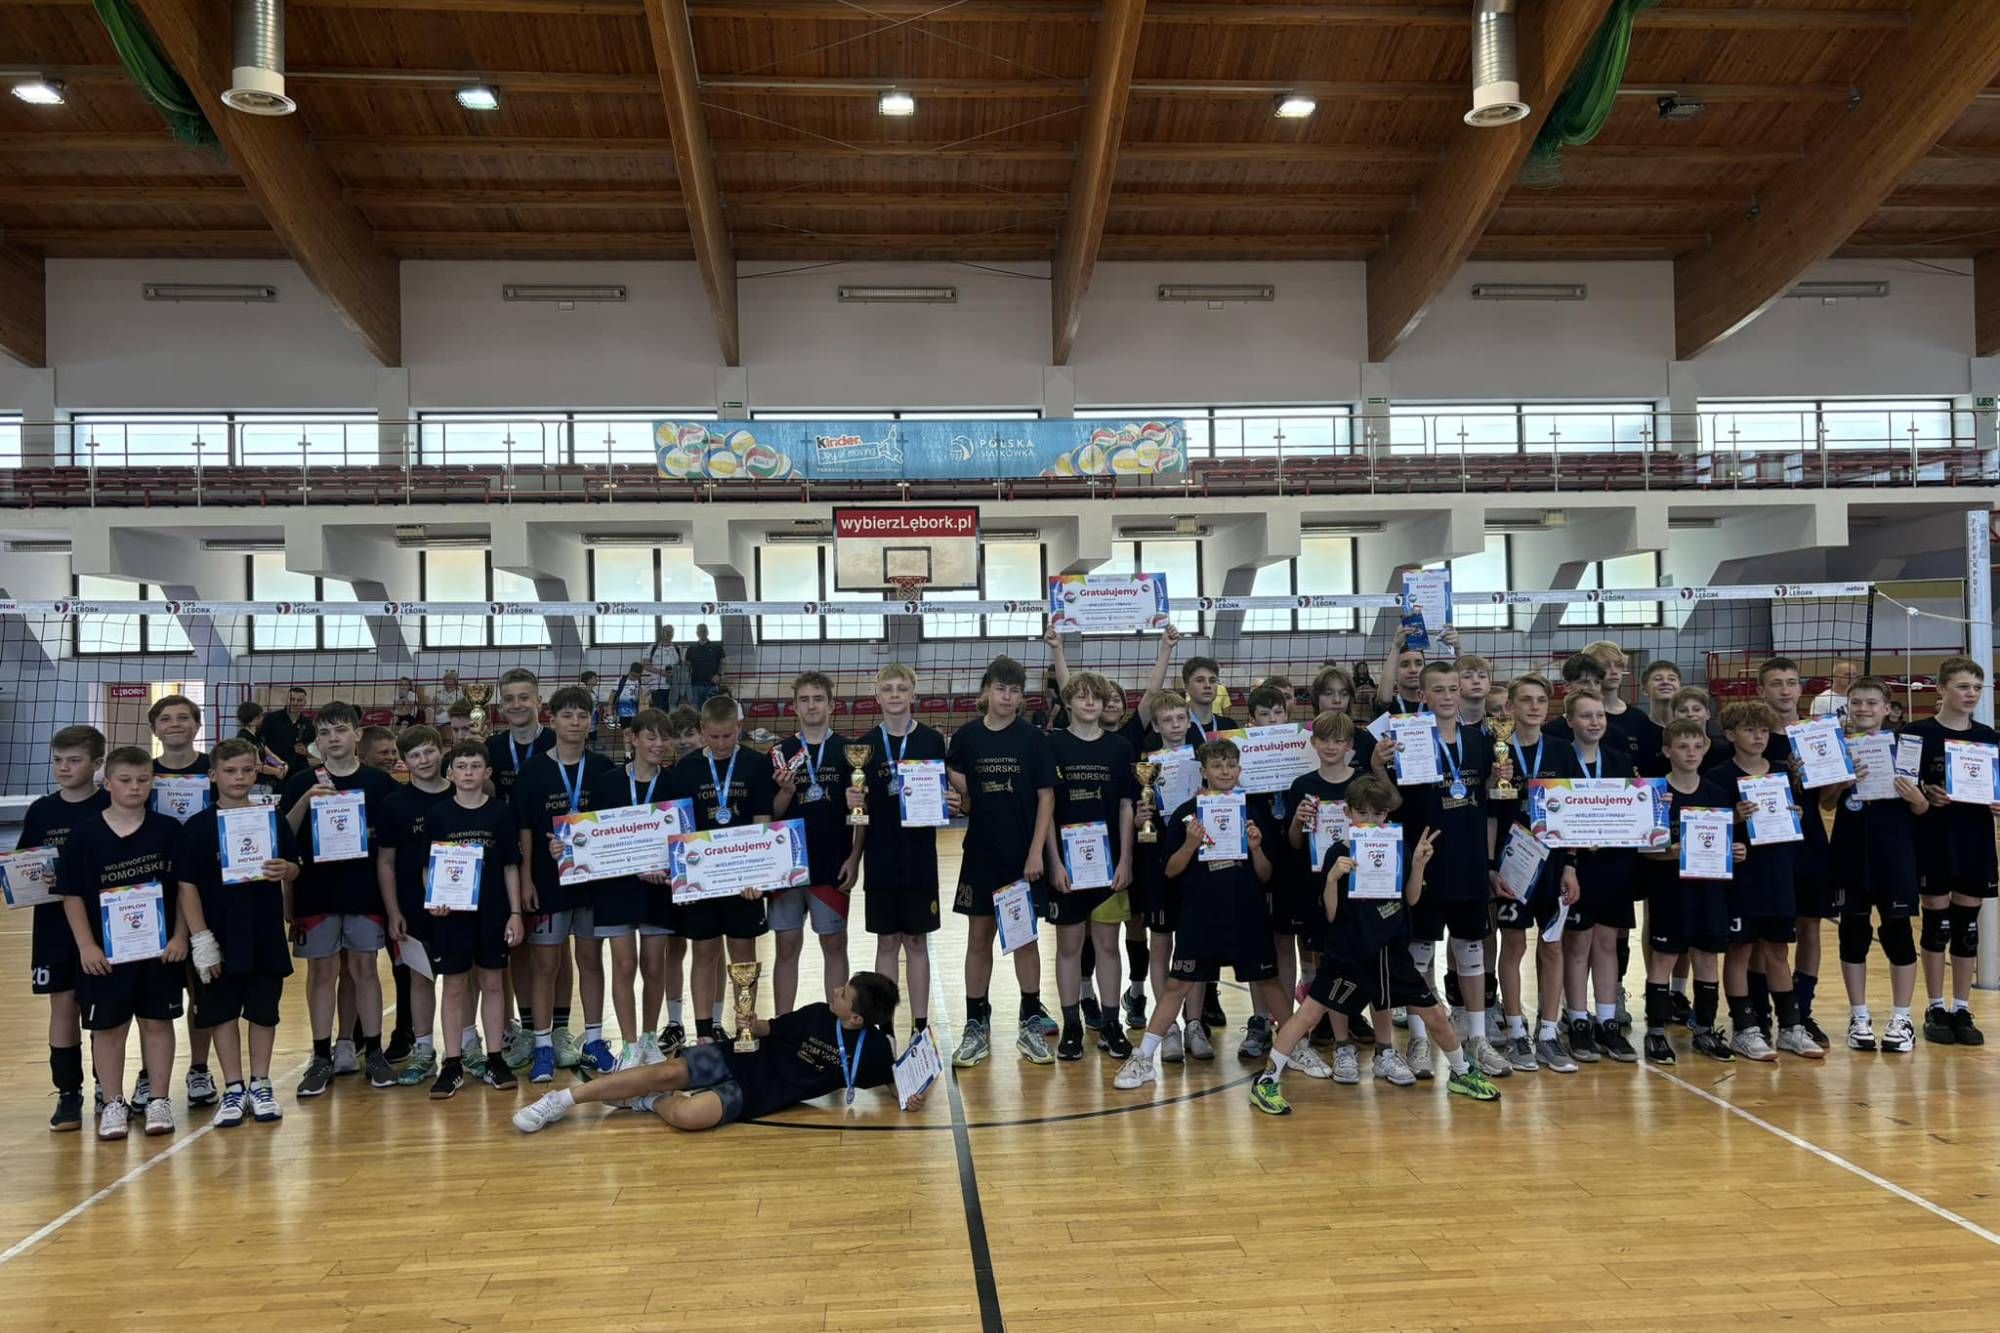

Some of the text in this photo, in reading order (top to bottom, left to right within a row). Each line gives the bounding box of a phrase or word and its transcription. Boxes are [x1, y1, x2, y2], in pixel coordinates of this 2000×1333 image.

[816, 436, 860, 449] Kinder
[980, 440, 1034, 448] POLSKA
[841, 516, 972, 532] wybierzLębork.pl
[1080, 588, 1138, 597] Gratulujemy
[1241, 740, 1307, 753] Gratulujemy
[1565, 795, 1633, 806] Gratulujemy
[591, 820, 660, 837] Gratulujemy
[704, 840, 772, 856] Gratulujemy
[1328, 977, 1357, 1004] 17
